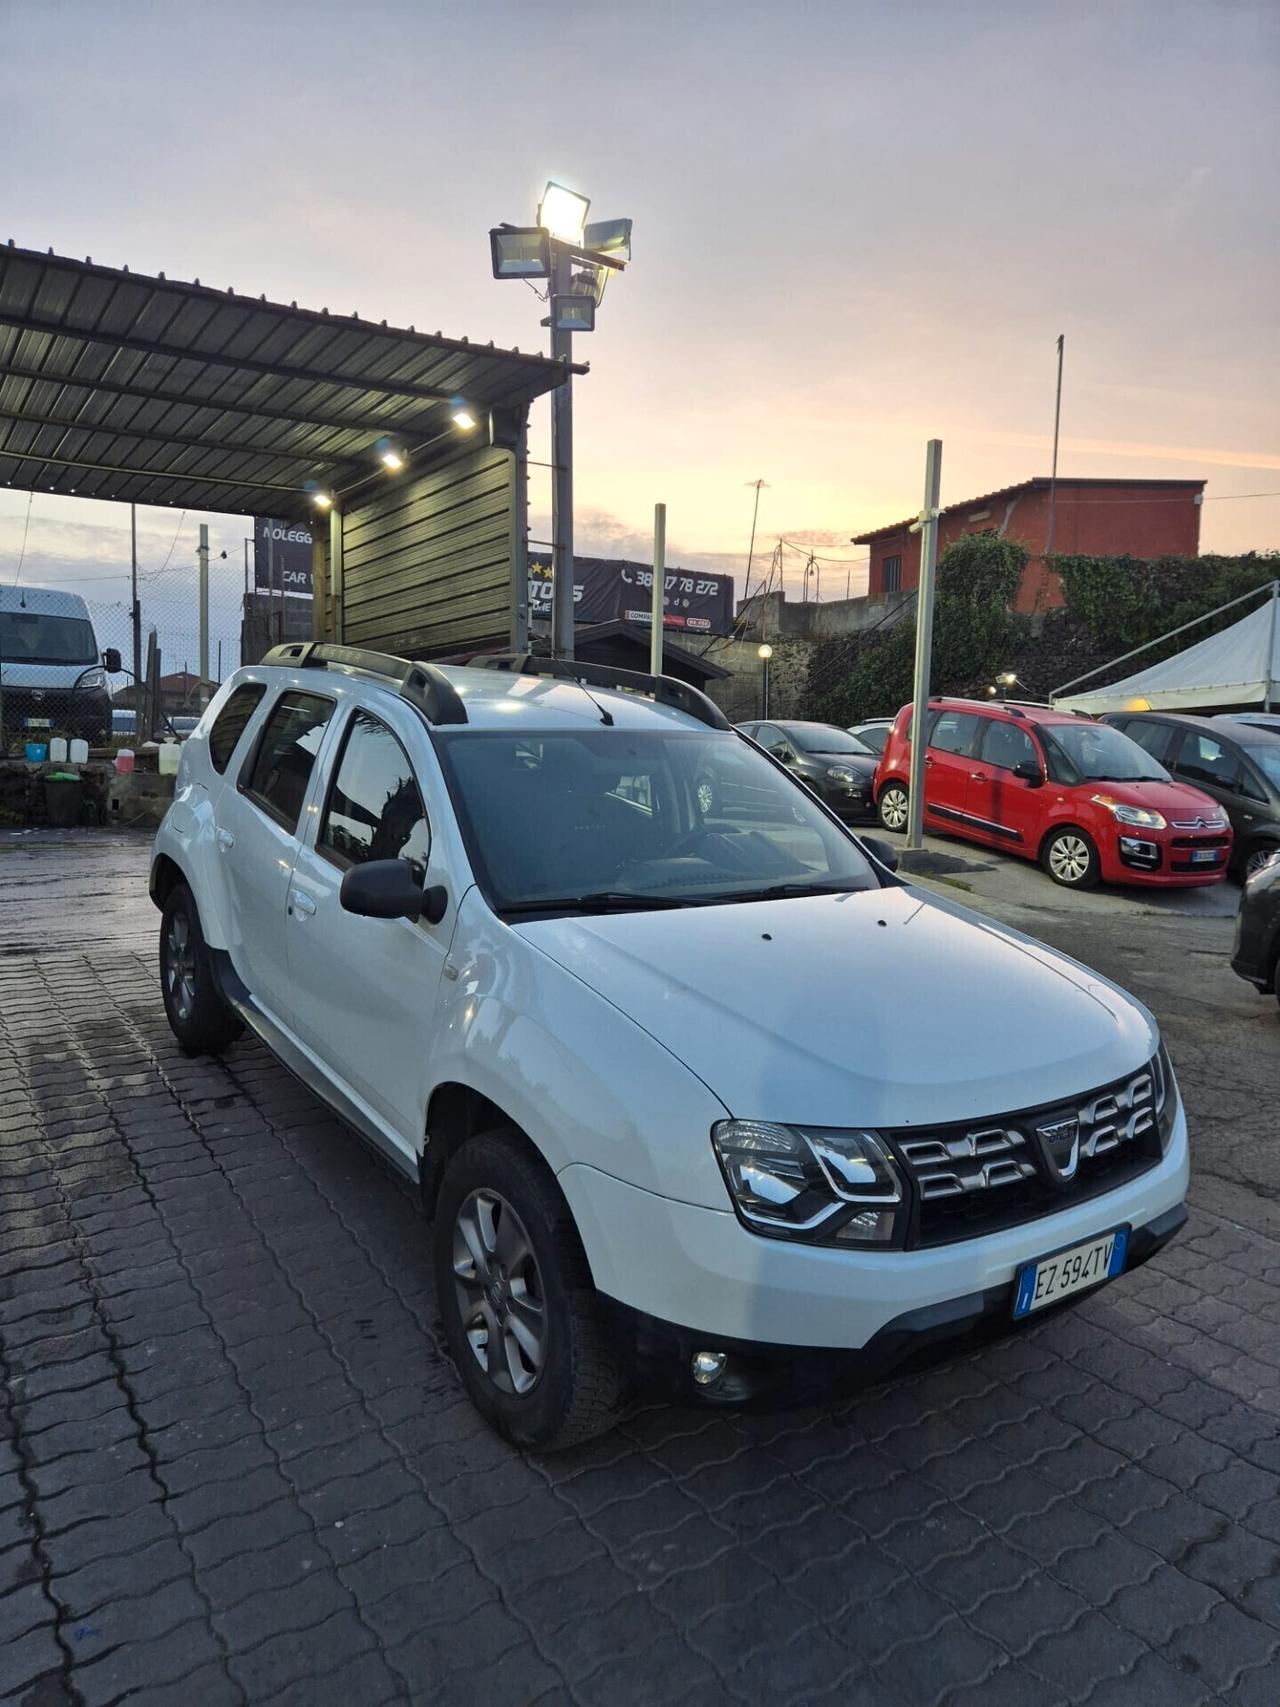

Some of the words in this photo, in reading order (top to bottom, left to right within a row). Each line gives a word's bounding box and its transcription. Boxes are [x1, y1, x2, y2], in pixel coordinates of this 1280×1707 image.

[283, 570, 307, 584] CAR
[680, 577, 694, 593] 78
[696, 580, 718, 596] 272
[1034, 1264, 1058, 1300] EZ
[1060, 1241, 1114, 1289] 594TV
